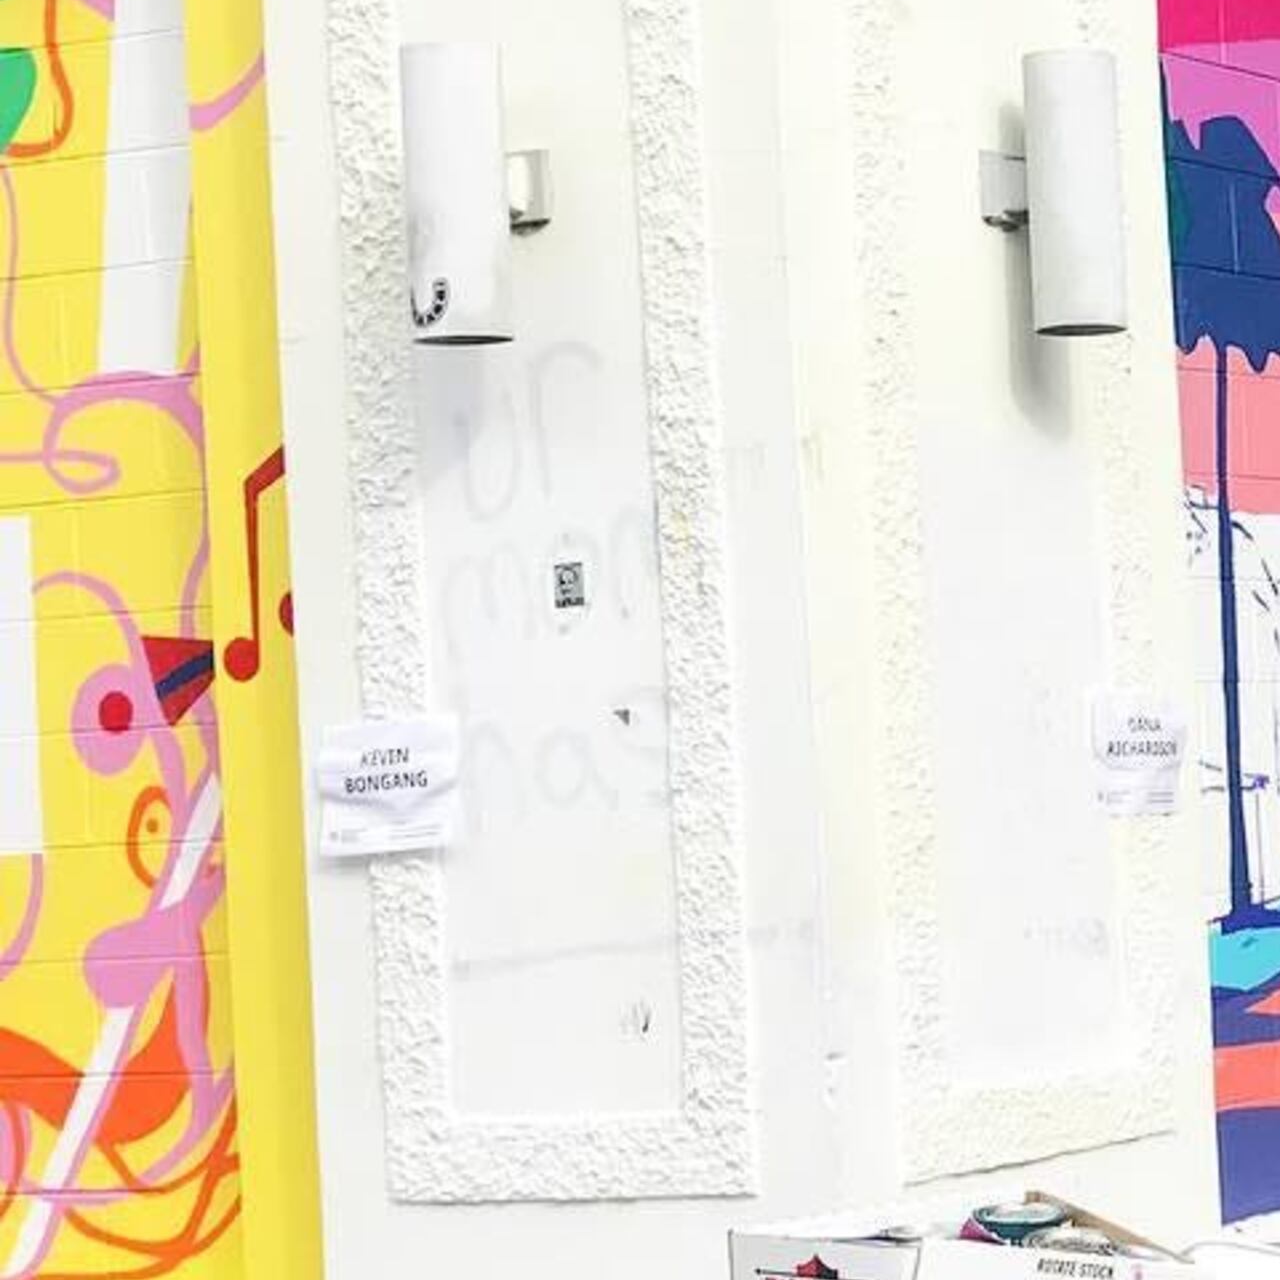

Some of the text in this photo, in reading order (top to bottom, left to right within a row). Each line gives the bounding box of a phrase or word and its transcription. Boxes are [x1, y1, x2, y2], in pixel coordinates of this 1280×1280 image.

[359, 746, 410, 768] KEVIN
[1105, 739, 1178, 757] RICHARDSON
[343, 770, 428, 794] BONGANG
[1079, 1262, 1114, 1280] STOCK
